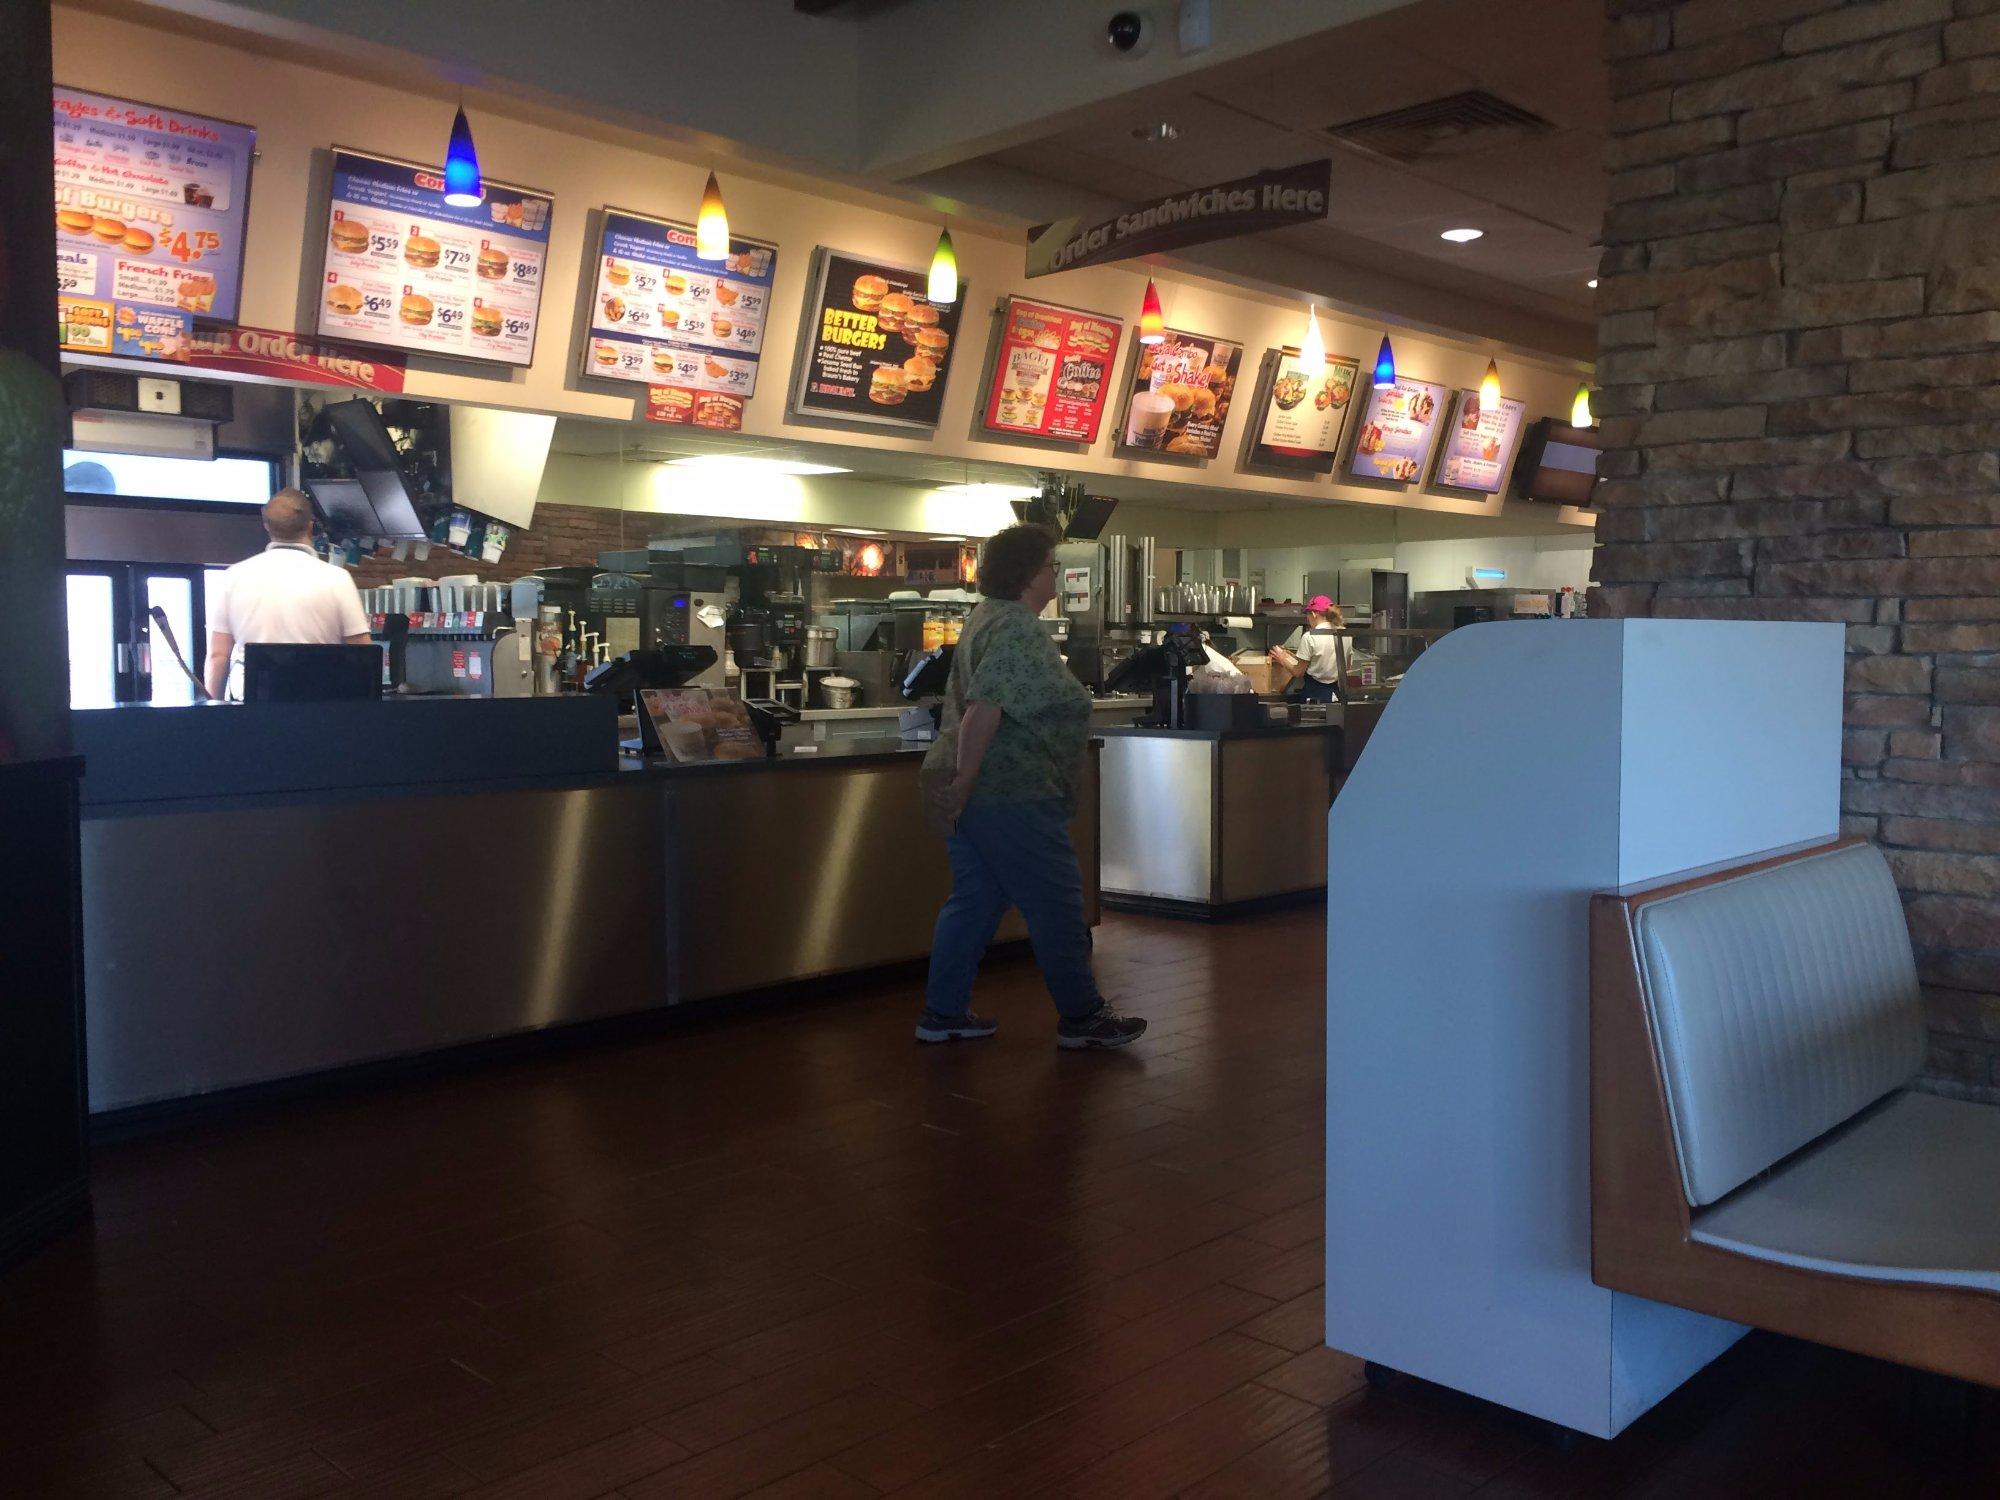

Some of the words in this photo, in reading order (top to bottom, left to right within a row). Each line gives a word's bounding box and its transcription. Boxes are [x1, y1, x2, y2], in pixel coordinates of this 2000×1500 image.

[124, 110, 163, 129] Soft
[168, 119, 219, 142] Drinks
[1050, 224, 1112, 271] Order
[1116, 188, 1256, 239] Sandwiches
[1262, 184, 1325, 214] Here
[117, 261, 168, 277] French
[173, 270, 210, 282] Fries
[824, 308, 878, 332] BETTER
[238, 331, 313, 363] Order
[821, 324, 887, 350] BURGERS
[1063, 362, 1102, 381] Coffee
[1173, 362, 1212, 389] Shake!
